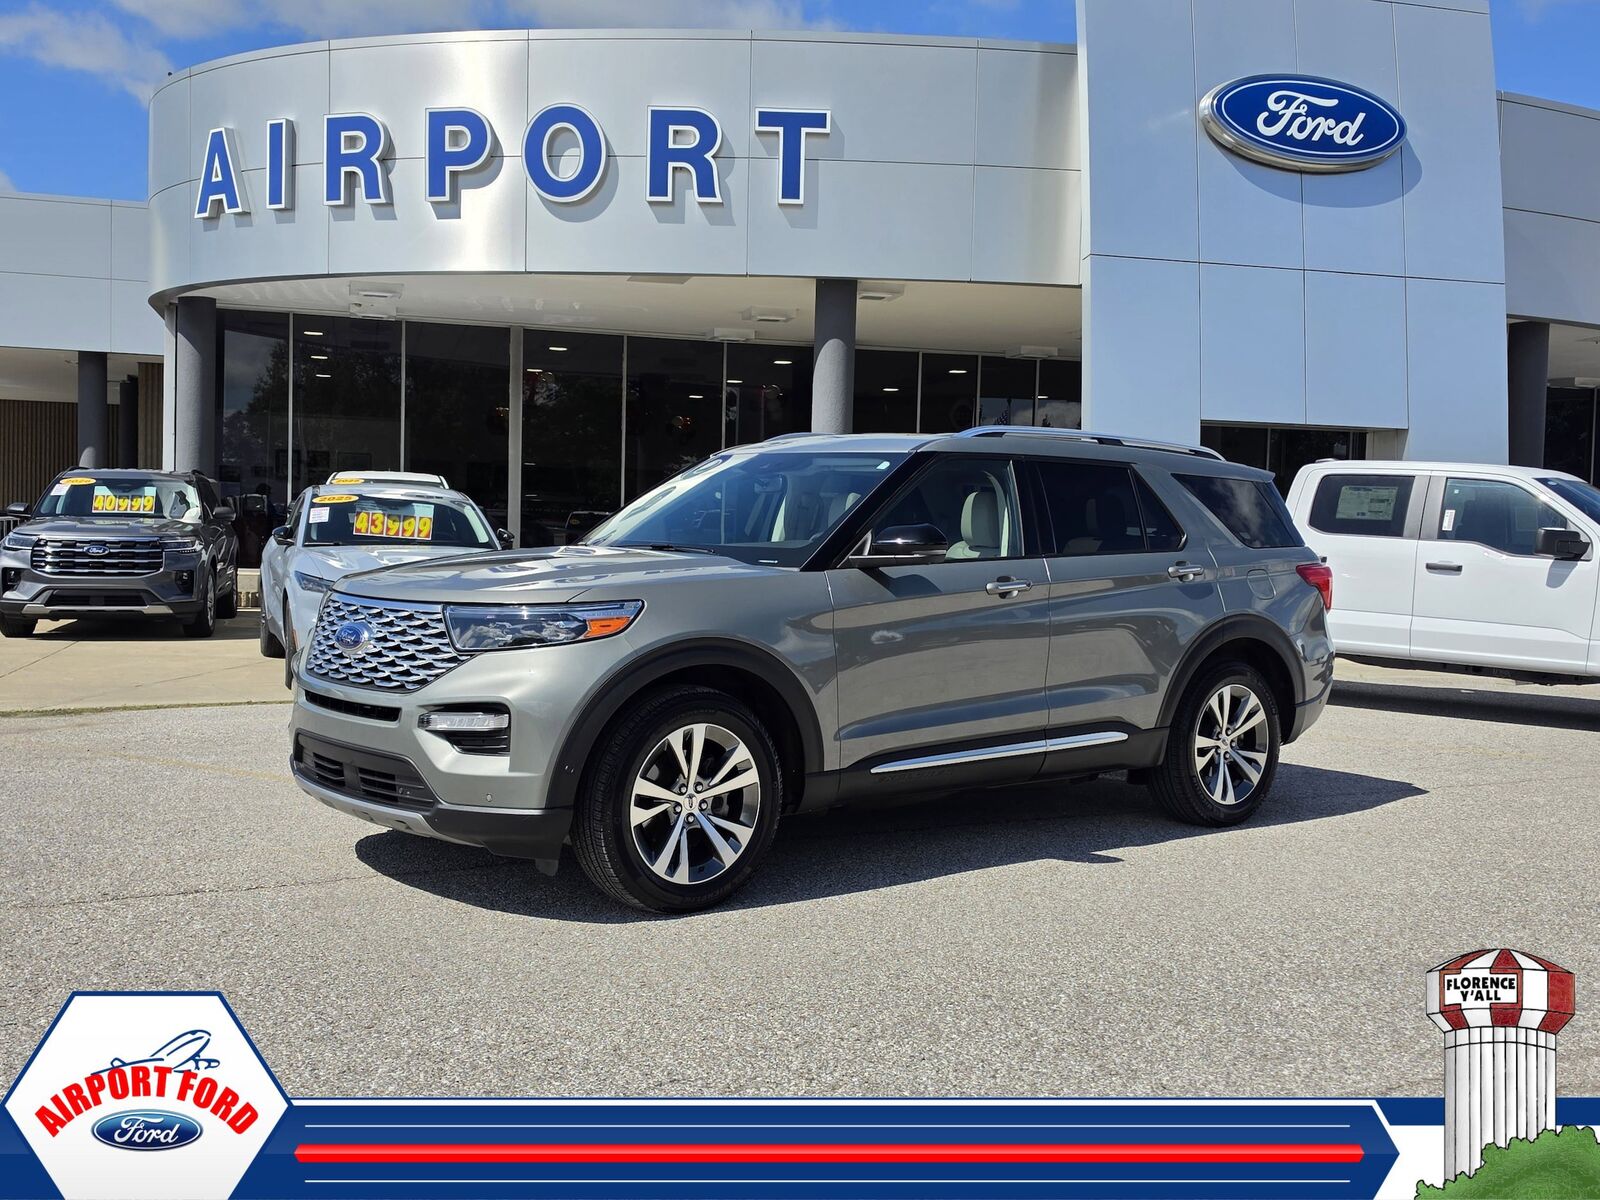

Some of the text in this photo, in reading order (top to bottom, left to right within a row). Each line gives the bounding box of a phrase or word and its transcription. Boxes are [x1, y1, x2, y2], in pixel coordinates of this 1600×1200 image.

[1256, 90, 1366, 146] Ford
[194, 102, 831, 219] AIRPORT
[93, 495, 154, 511] 40999
[355, 511, 431, 538] 43999
